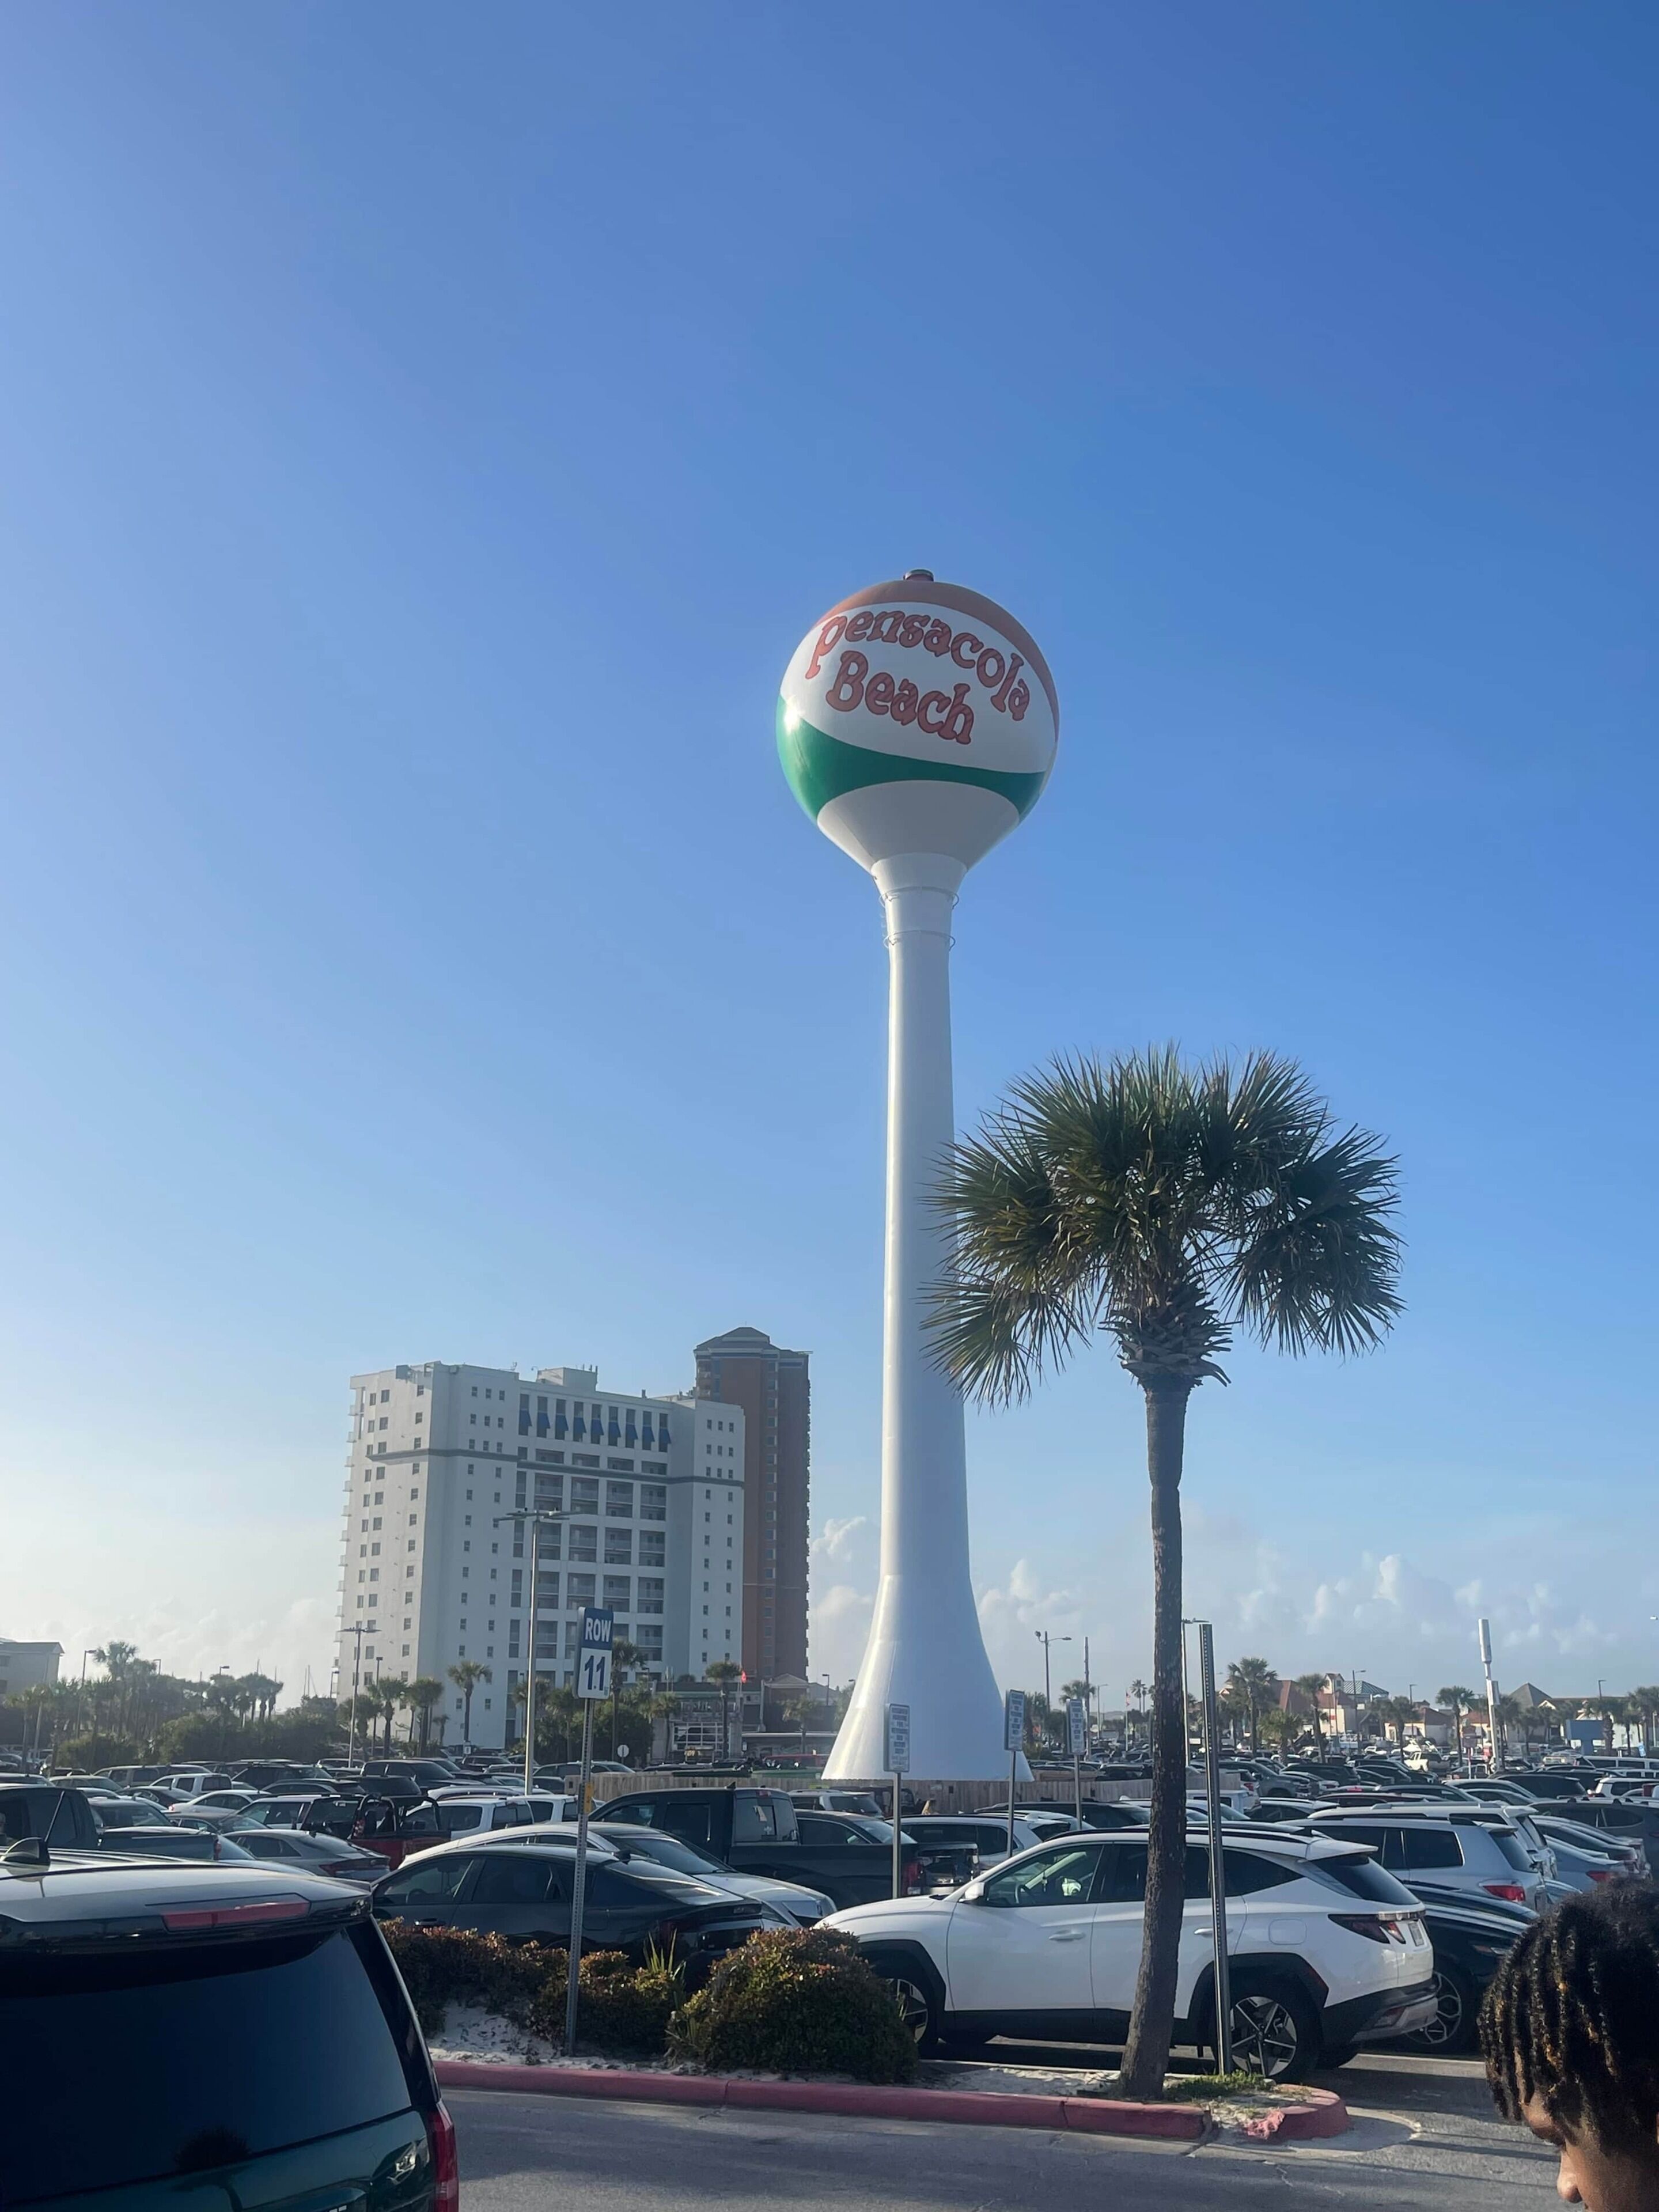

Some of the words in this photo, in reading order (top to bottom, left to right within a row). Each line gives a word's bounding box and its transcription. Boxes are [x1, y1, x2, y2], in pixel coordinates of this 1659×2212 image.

[825, 650, 974, 745] Beach
[585, 1617, 612, 1642] ROW
[584, 1655, 605, 1691] 11
